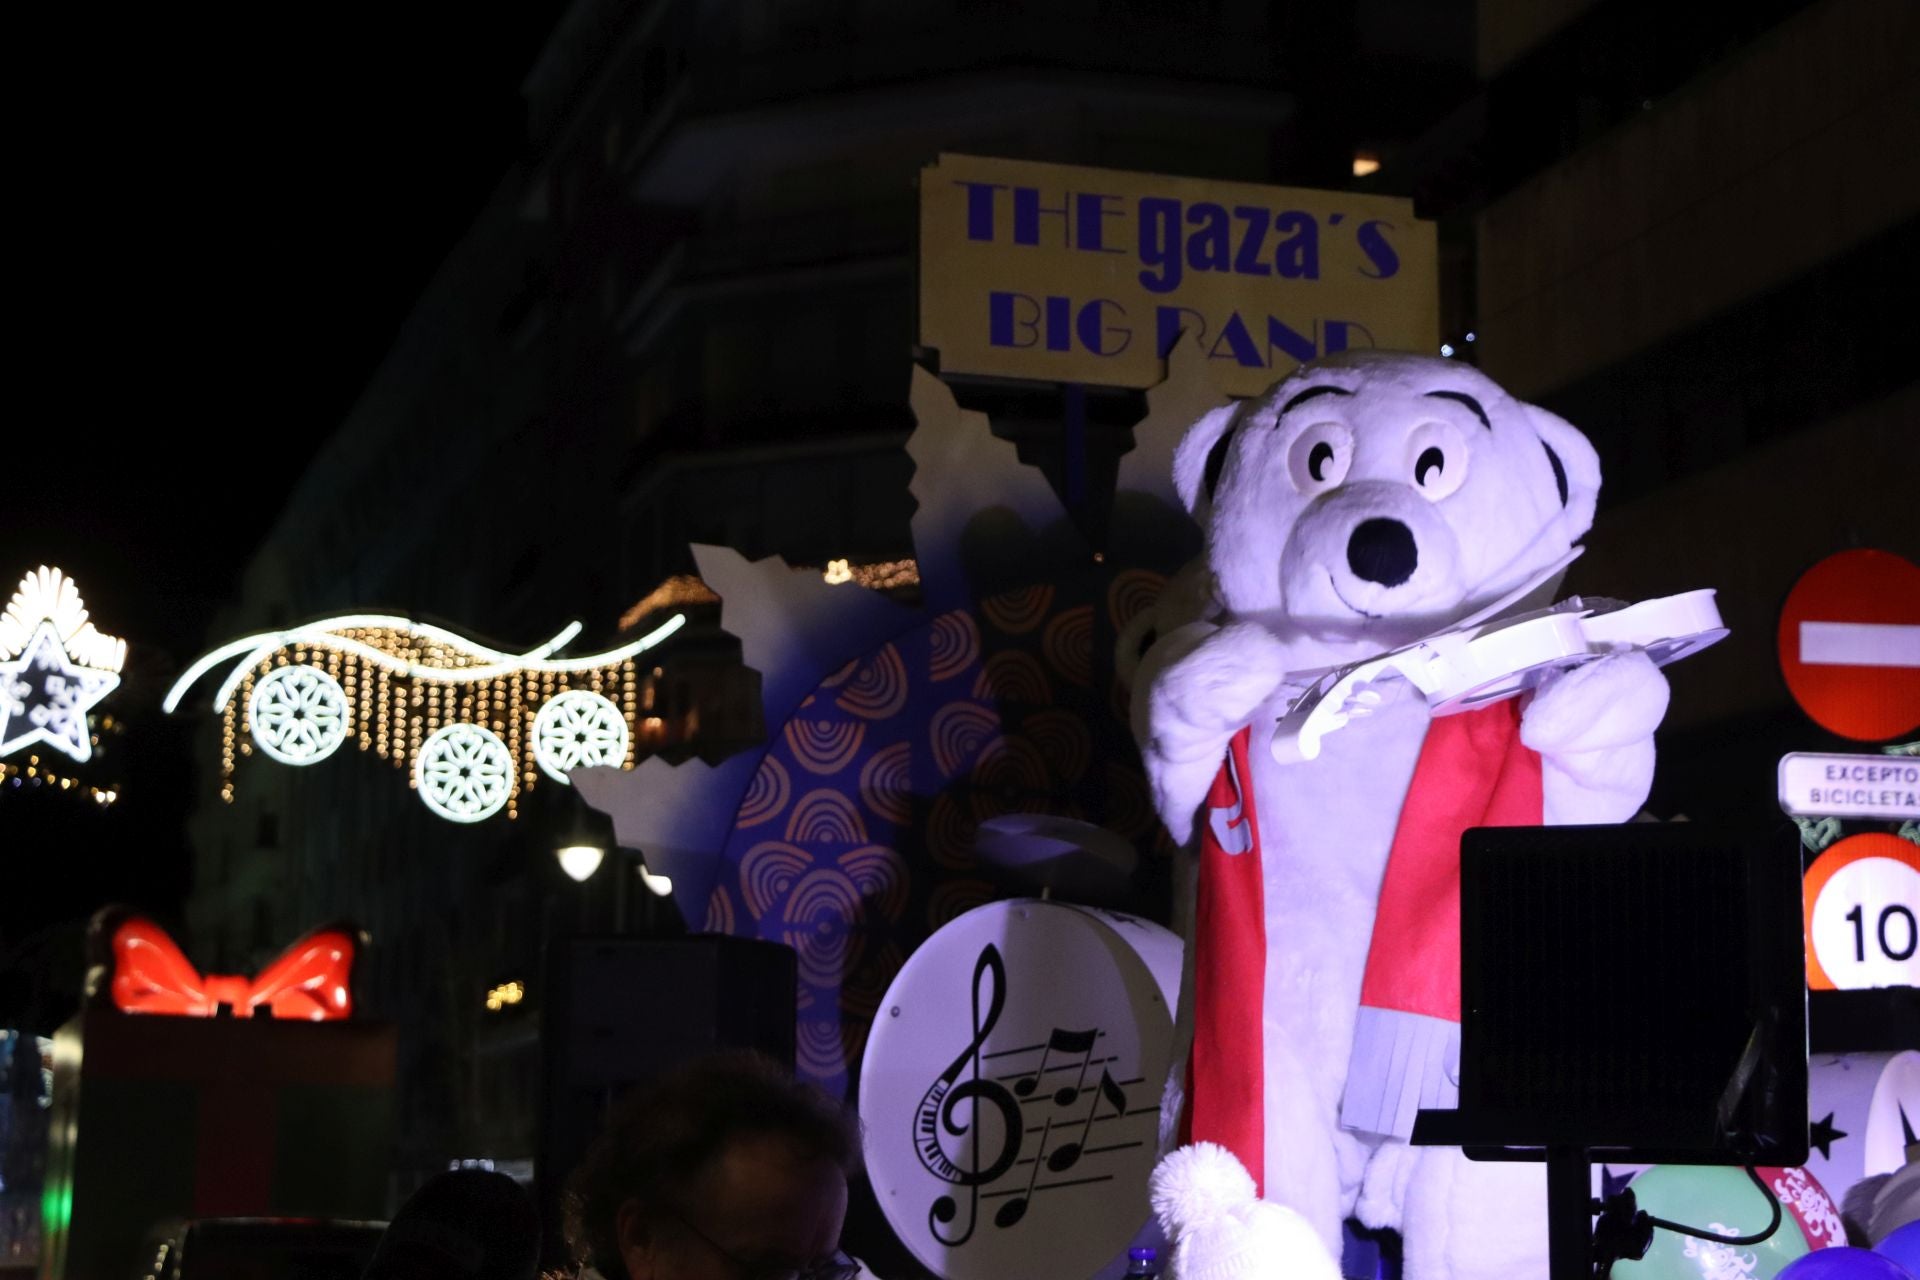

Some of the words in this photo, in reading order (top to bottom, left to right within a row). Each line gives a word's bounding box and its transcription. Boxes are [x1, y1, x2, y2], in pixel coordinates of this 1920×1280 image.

[953, 180, 1127, 254] THE
[990, 292, 1132, 357] BIG
[1810, 788, 1920, 806] BICICLETA
[1825, 764, 1919, 783] EXCEPTO
[1845, 904, 1918, 961] 10
